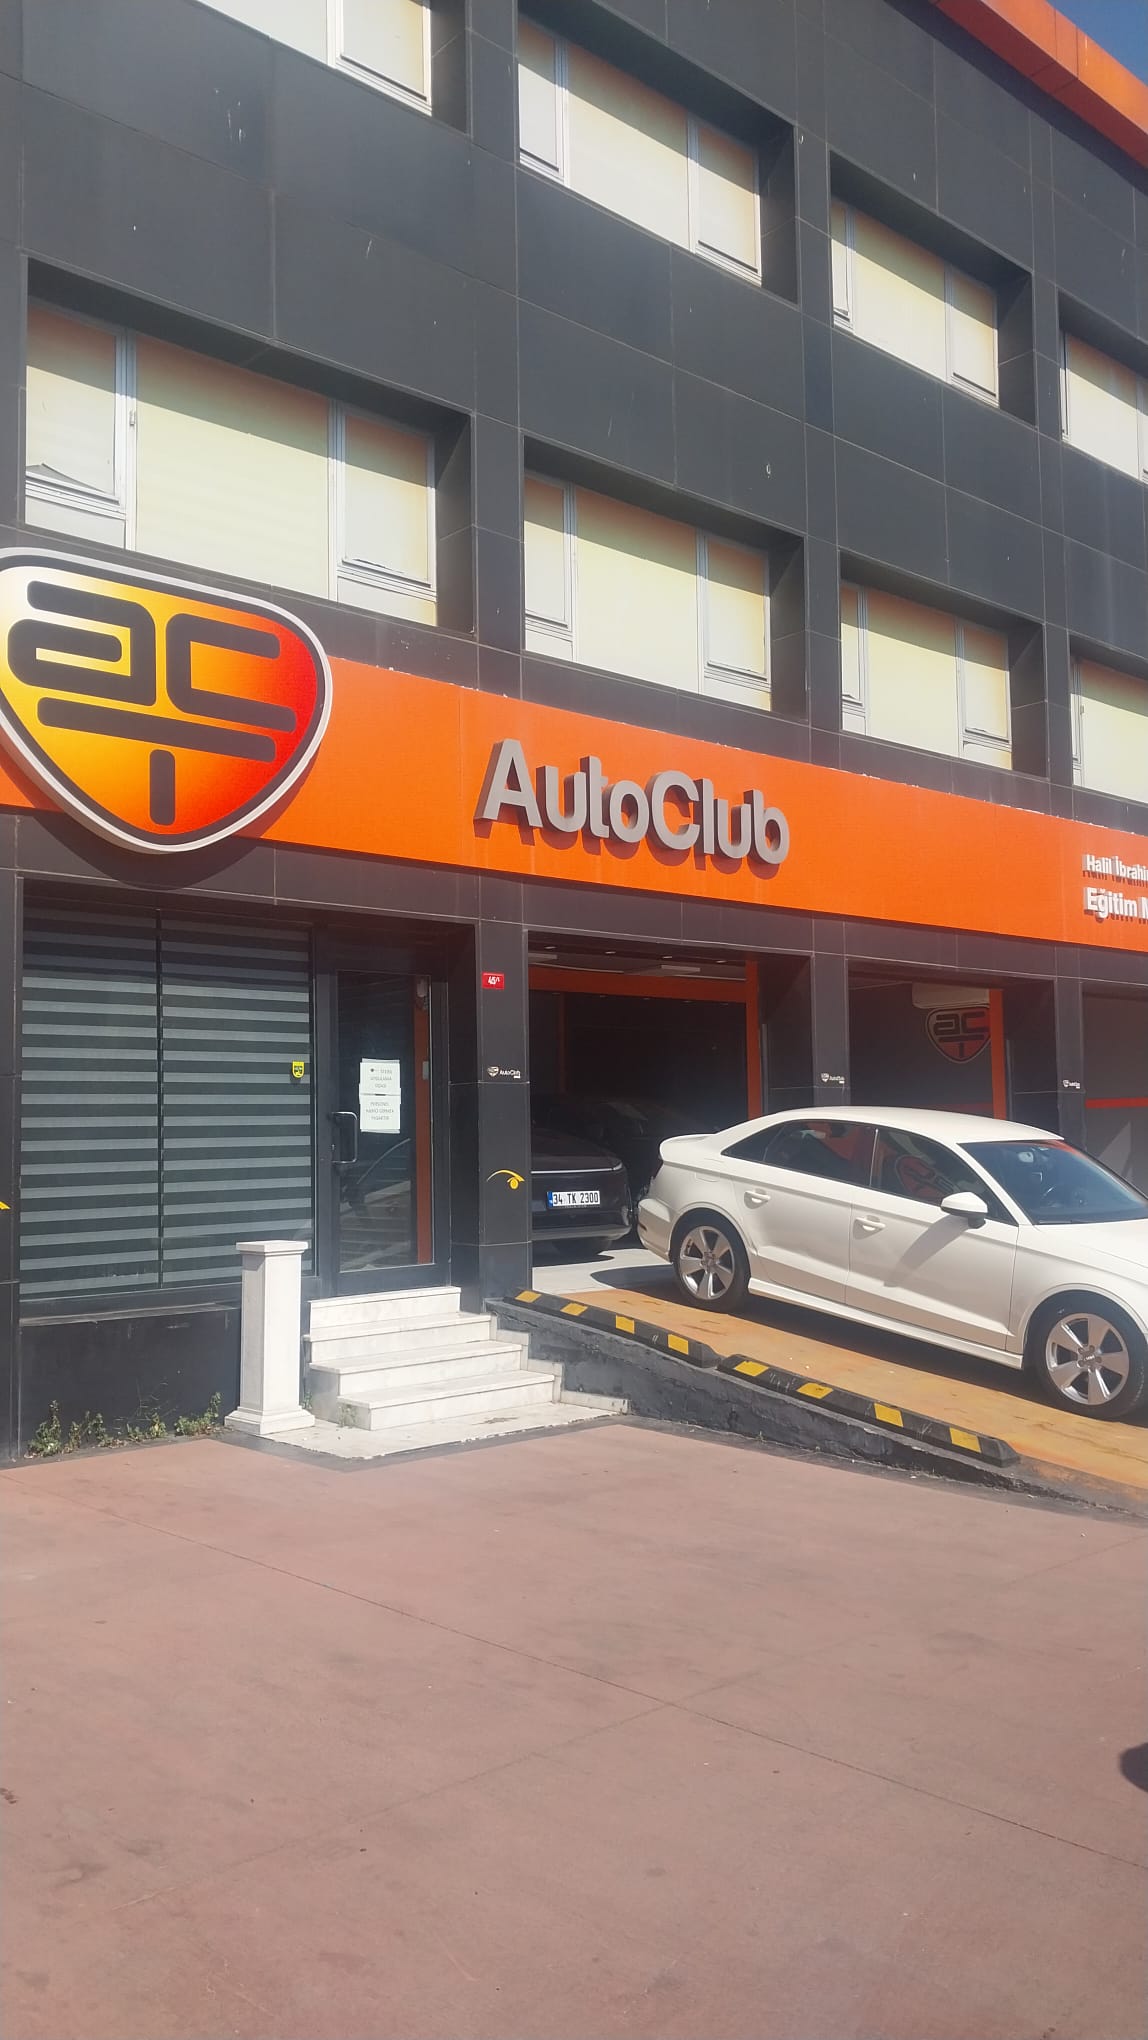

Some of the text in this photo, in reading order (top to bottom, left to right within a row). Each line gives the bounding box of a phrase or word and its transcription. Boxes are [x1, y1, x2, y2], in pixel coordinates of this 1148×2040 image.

[473, 738, 789, 864] AutoClub
[1083, 854, 1148, 881] Halil İbrahi
[1083, 887, 1137, 918] Eğitim
[553, 1192, 599, 1205] 34 TK 2300
